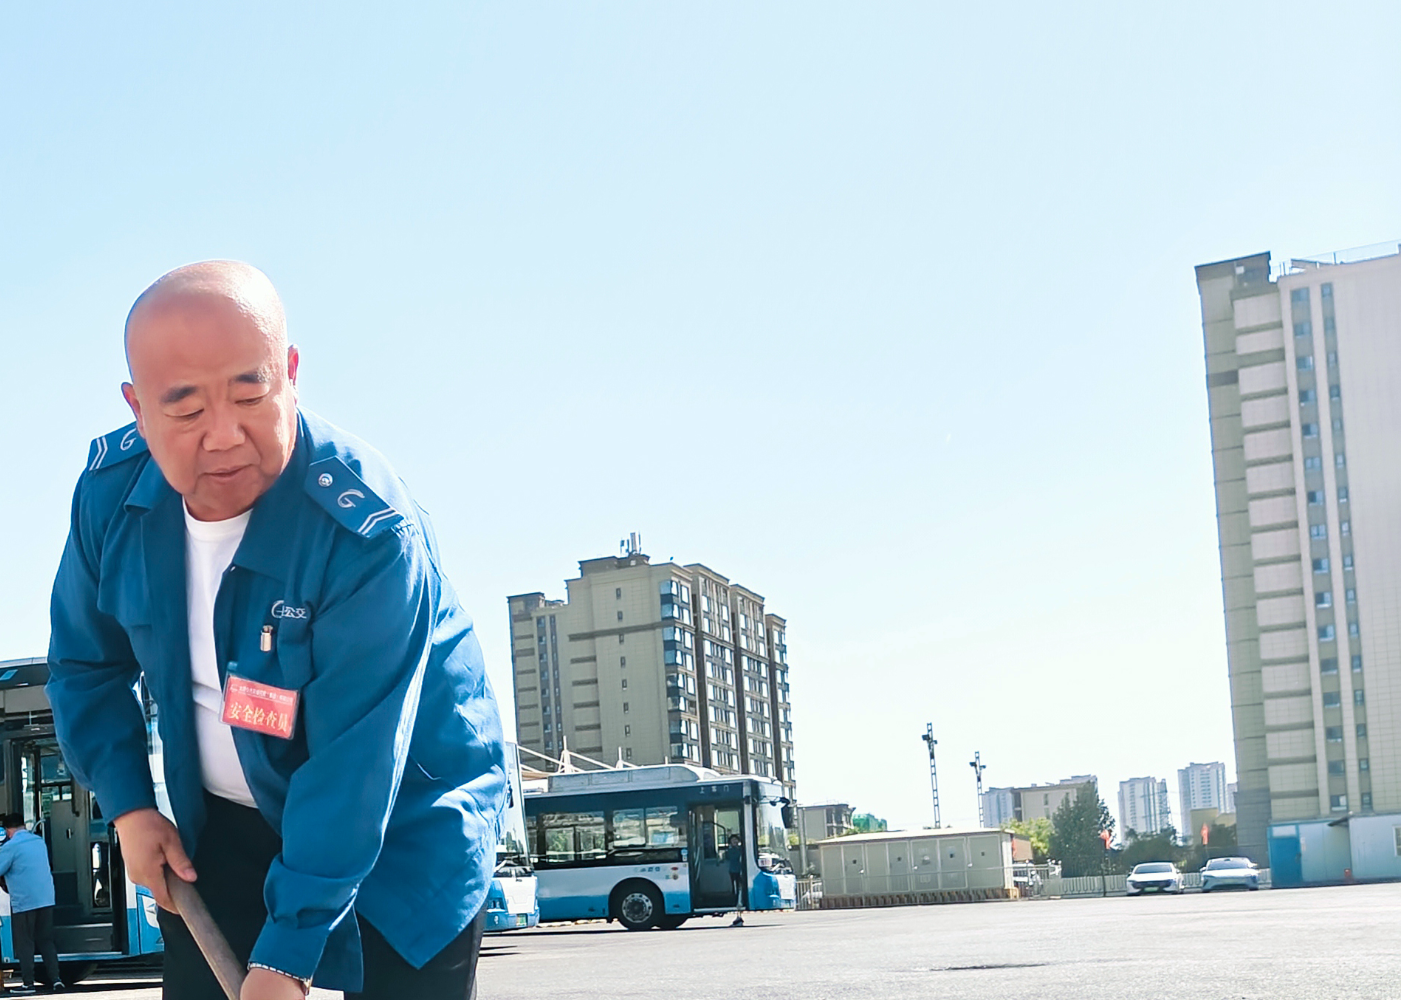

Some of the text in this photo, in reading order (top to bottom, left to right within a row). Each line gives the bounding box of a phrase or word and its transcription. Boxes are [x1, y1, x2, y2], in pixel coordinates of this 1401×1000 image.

[283, 605, 307, 619] 公交
[229, 702, 289, 732] 安全检查员
